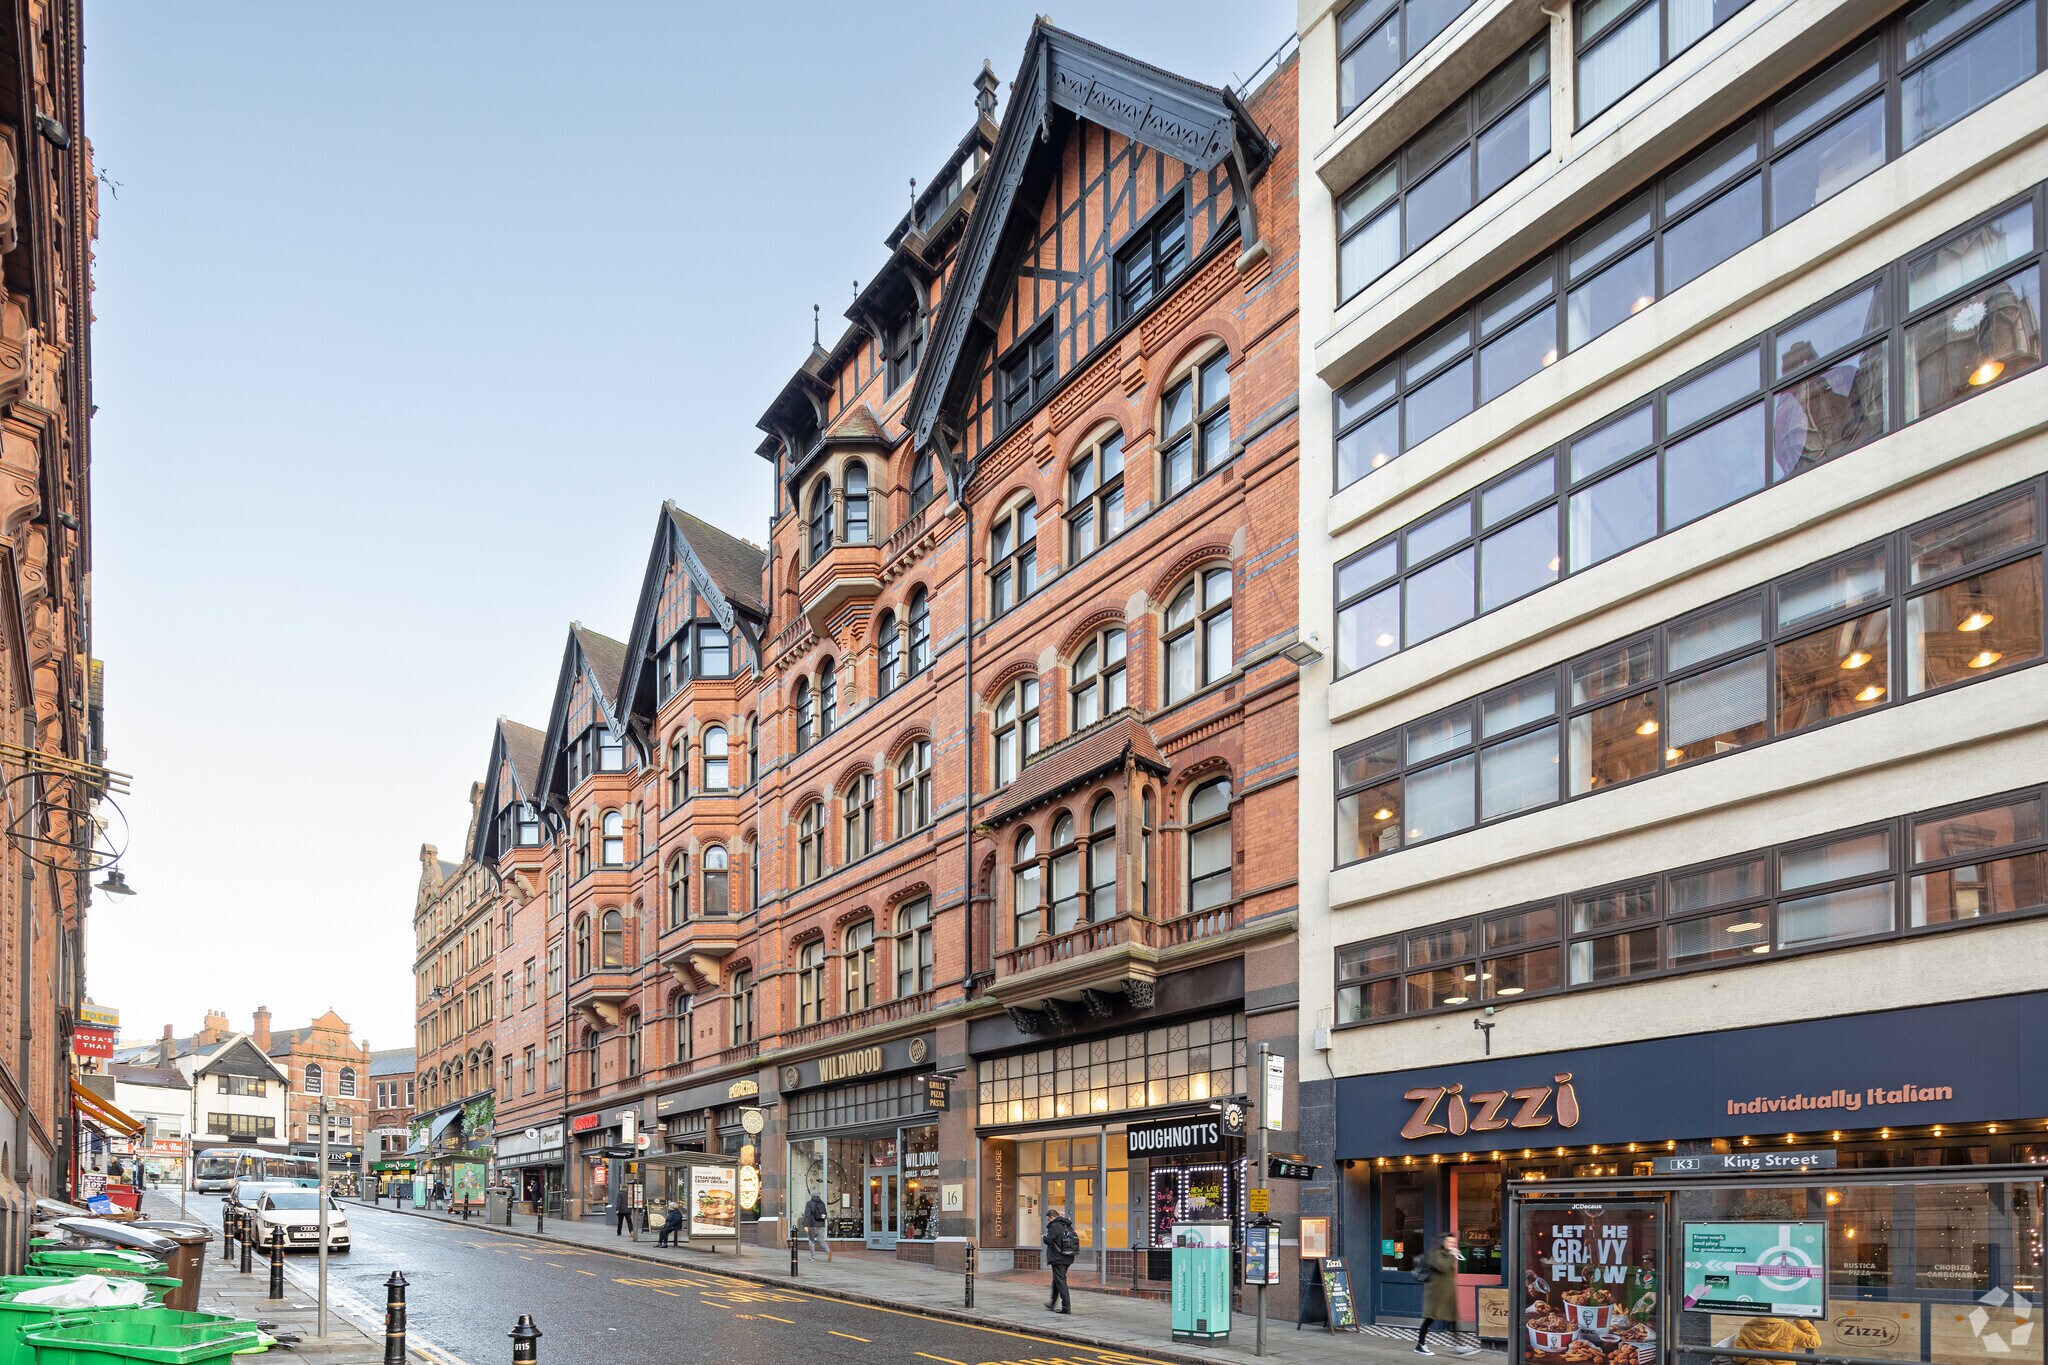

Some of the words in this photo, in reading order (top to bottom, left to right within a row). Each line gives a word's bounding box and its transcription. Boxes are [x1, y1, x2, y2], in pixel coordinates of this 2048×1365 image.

[84, 1011, 96, 1019] TO
[98, 1014, 114, 1022] LET
[76, 1034, 112, 1043] ROSA'S
[818, 1046, 883, 1082] WILDWOOD
[928, 1081, 946, 1090] GRILLS
[930, 1090, 945, 1099] PIZZA
[1726, 1089, 1862, 1116] Individually
[1866, 1083, 1953, 1106] Italian
[929, 1099, 945, 1107] PASTA
[1129, 1122, 1219, 1151] DOUGHNOTTS
[905, 1151, 939, 1168] WILDWOO
[995, 1149, 1003, 1181] HOUSE
[1676, 1159, 1694, 1169] K3
[1724, 1155, 1761, 1170] King
[1765, 1153, 1819, 1166] Street
[1206, 1185, 1220, 1193] LATE
[947, 1191, 958, 1206] 16
[995, 1182, 1003, 1237] FOTHERGILL
[1552, 1224, 1586, 1238] LET
[1551, 1238, 1628, 1265] GRAVY
[1551, 1264, 1628, 1284] FLOW
[1934, 1263, 1971, 1271] CHORIZO
[1926, 1271, 1979, 1279] CARBONARA
[1491, 1307, 1509, 1317] Ziz
[1843, 1324, 1888, 1338] Zizzi
[515, 1342, 530, 1351] 0115
